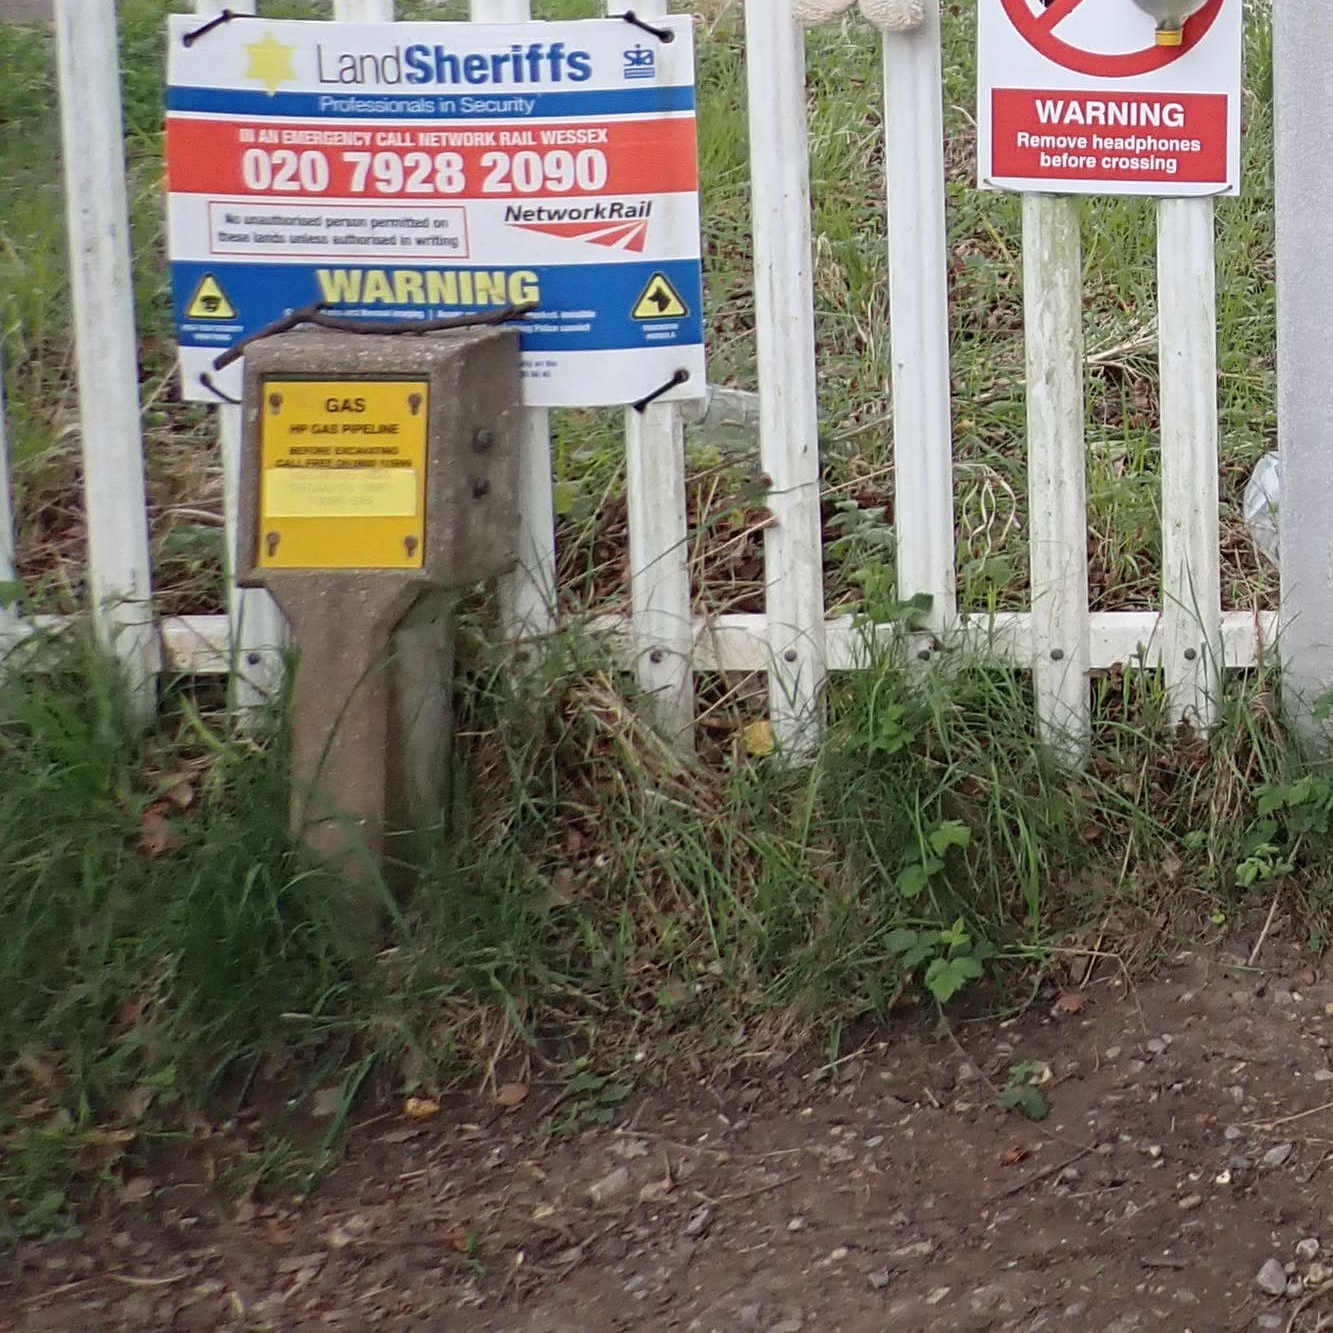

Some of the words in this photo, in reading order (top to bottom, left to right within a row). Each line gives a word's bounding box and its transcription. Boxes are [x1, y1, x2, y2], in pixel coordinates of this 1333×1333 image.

[316, 42, 593, 85] LandSheriffs
[320, 96, 435, 114] Professionals
[440, 97, 456, 113] in
[460, 96, 537, 116] Security
[1035, 99, 1186, 128] WARNING
[238, 128, 256, 143] IN
[258, 129, 280, 144] AN
[281, 130, 374, 147] EMERGENCY
[376, 131, 416, 147] CALL
[419, 130, 497, 147] NETWORK
[500, 130, 537, 146] RAIL
[540, 128, 608, 145] WESSEX
[1016, 131, 1087, 150] Remove
[1092, 132, 1201, 154] headphones
[242, 148, 330, 192] 020
[342, 151, 467, 194] 7928
[481, 149, 609, 193] 2090
[1040, 152, 1097, 169] before
[1101, 154, 1178, 174] crossing
[326, 216, 368, 229] person
[371, 216, 430, 230] permitted
[433, 217, 449, 228] on
[416, 235, 459, 249] writing
[316, 268, 540, 304] WARNING
[325, 397, 366, 413] GAS
[341, 423, 400, 435] PIPELINE
